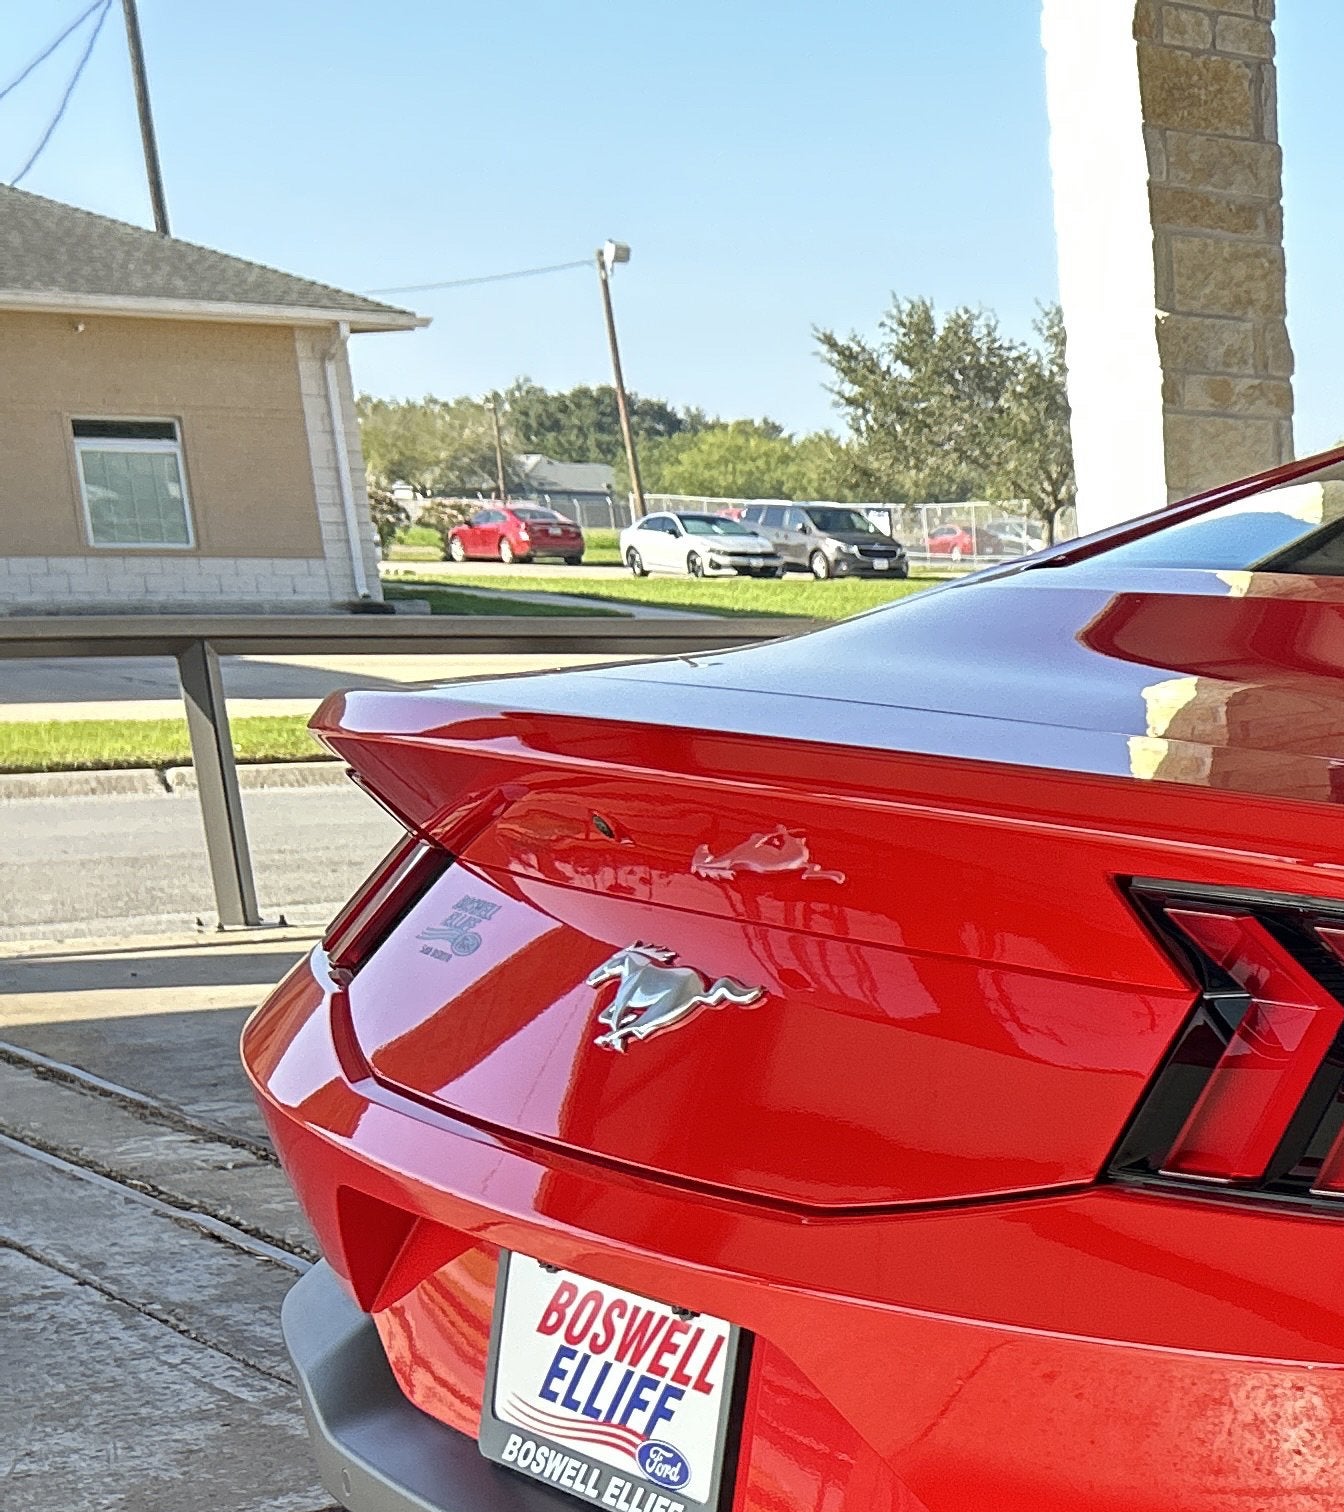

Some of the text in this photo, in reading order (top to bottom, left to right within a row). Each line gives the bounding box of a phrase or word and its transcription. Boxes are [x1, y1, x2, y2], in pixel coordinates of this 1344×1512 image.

[536, 1280, 726, 1395] BOSWELL
[538, 1344, 686, 1438] ELLIFF
[502, 1433, 600, 1499] BOSWELL
[645, 1446, 682, 1484] Ford
